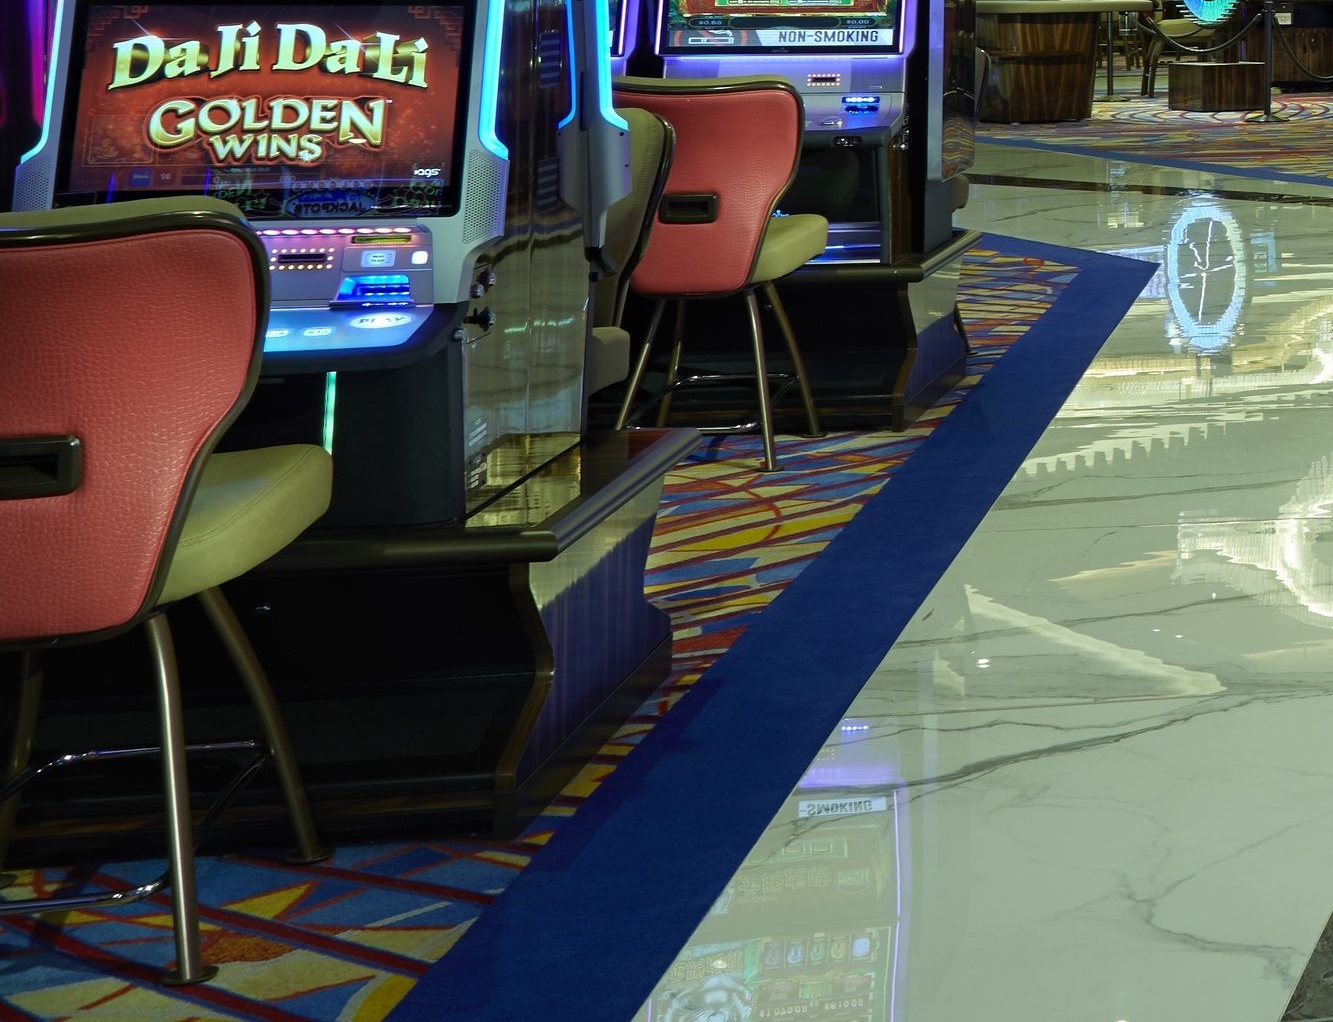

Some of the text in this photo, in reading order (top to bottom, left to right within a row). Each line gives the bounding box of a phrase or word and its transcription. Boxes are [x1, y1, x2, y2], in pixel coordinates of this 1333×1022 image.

[779, 31, 879, 43] NON-SMOKING
[148, 97, 385, 147] GOLDEN
[209, 132, 323, 162] WINS
